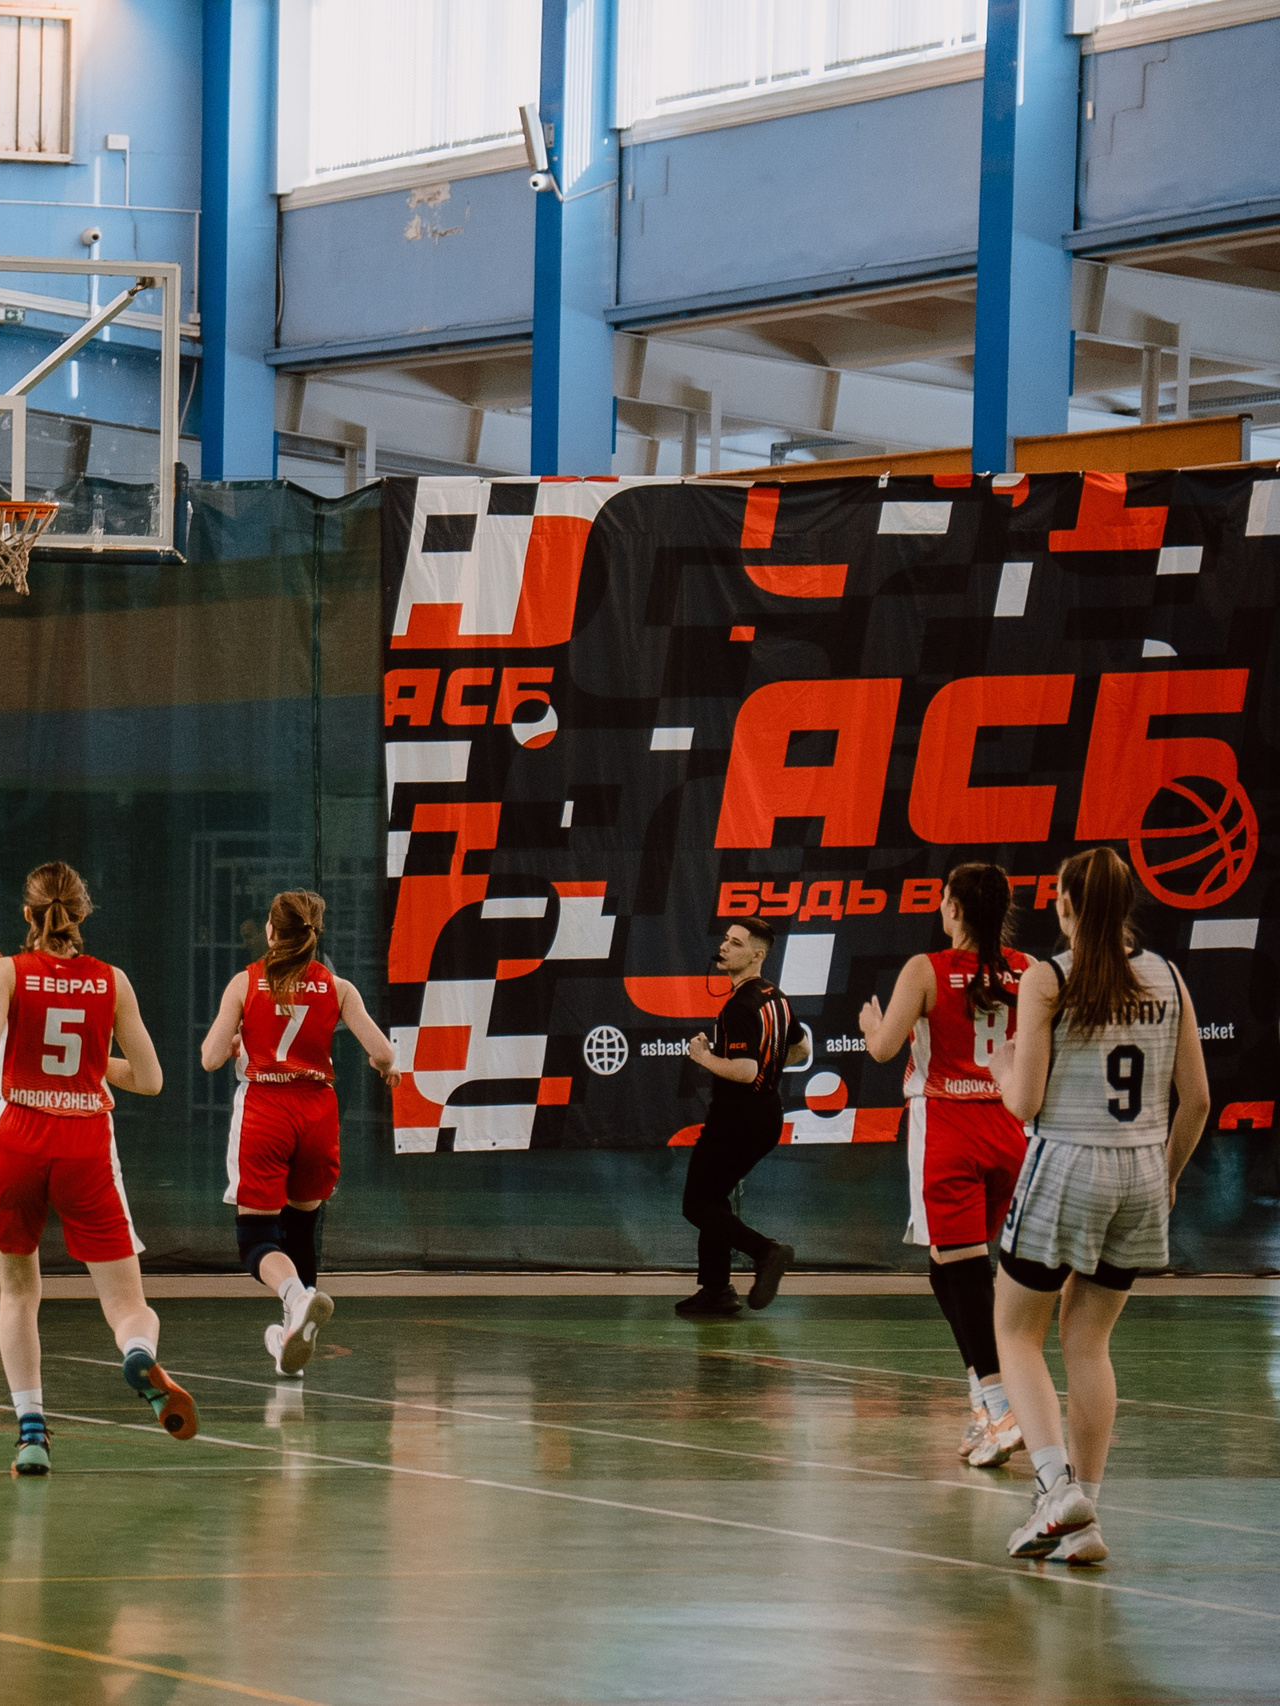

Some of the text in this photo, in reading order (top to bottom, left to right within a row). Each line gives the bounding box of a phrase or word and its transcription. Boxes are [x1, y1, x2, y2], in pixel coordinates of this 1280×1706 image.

[384, 667, 554, 727] АСБ
[714, 668, 1250, 849] АСБ
[717, 879, 888, 922] БУДЬ
[898, 878, 944, 914] В
[43, 976, 108, 994] ЕВРАЗ
[41, 1007, 86, 1077] 5
[275, 1003, 310, 1062] 7
[826, 1034, 867, 1052] asbas
[973, 1001, 1009, 1068] 8
[1107, 1043, 1145, 1122] 9
